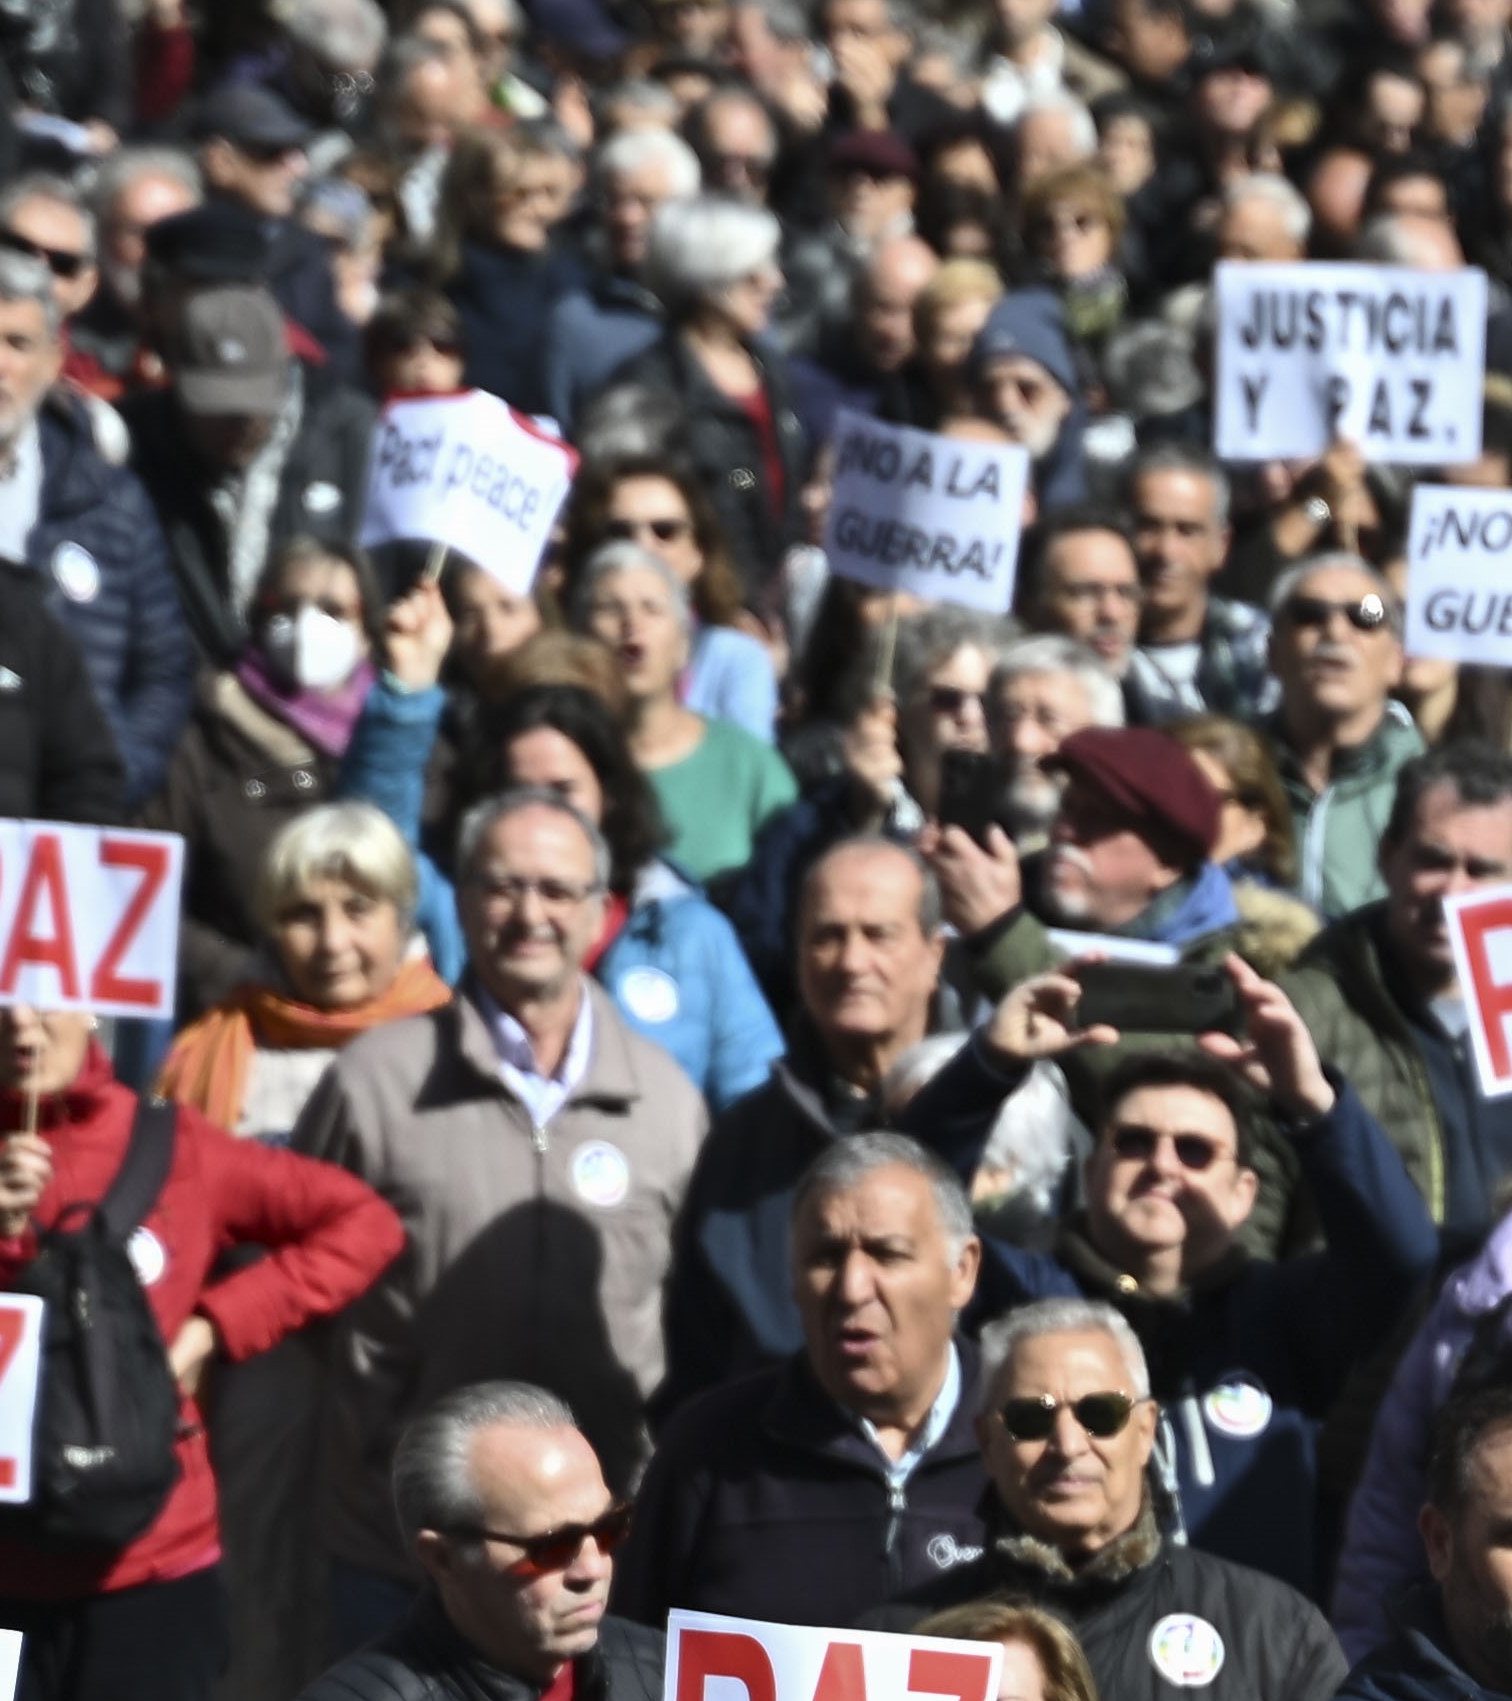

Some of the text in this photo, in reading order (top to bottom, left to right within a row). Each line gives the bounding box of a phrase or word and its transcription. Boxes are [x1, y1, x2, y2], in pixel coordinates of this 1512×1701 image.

[1240, 289, 1458, 353] JUSTICIA
[1240, 377, 1269, 434] Y
[904, 448, 933, 492] A
[946, 457, 1001, 502] LA
[835, 506, 1005, 582] GUERRA!
